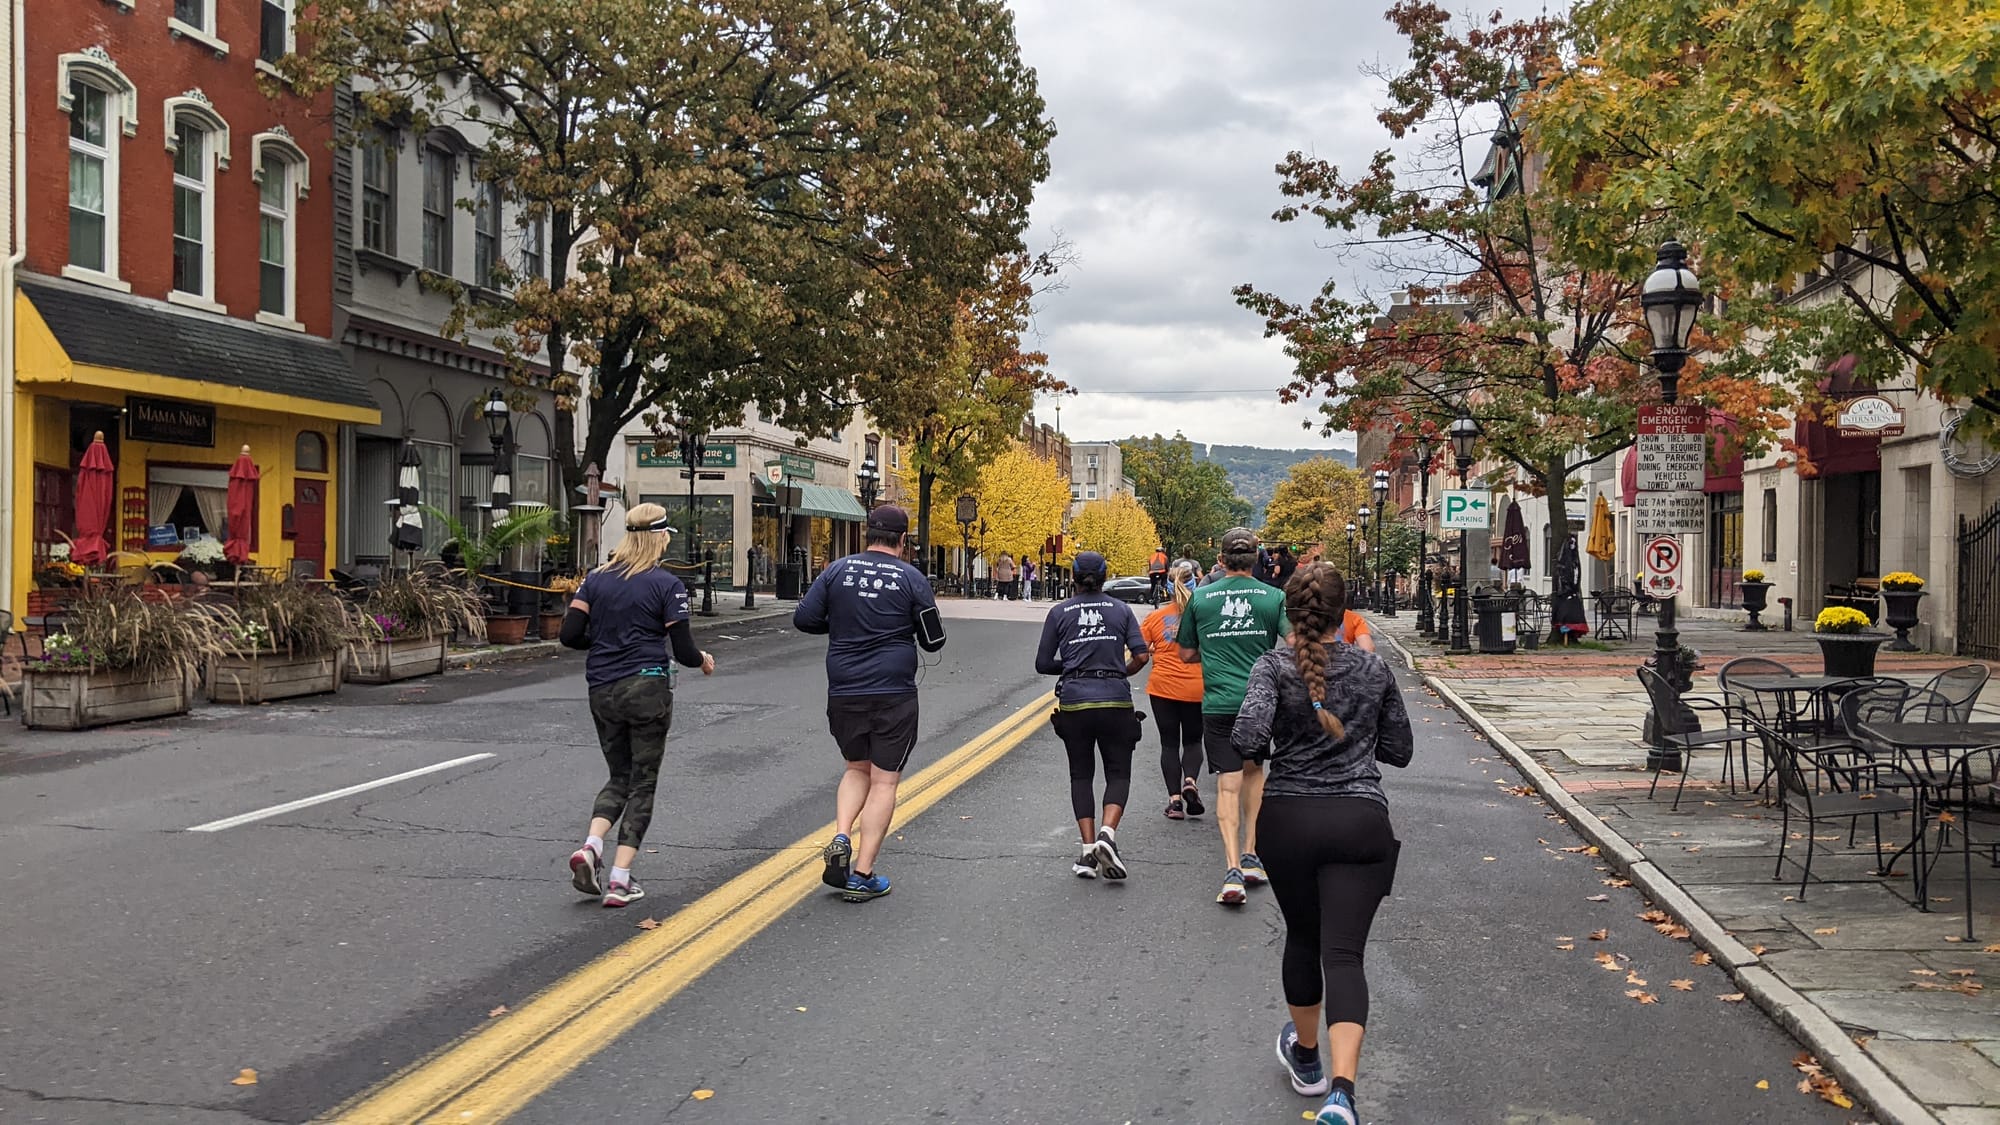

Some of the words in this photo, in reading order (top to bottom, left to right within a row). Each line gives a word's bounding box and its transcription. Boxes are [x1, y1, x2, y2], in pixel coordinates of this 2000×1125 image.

[1655, 406, 1688, 415] SNOW
[1852, 401, 1890, 415] CIGARS
[139, 405, 177, 424] MAMA
[1641, 415, 1702, 425] EMERGENCY
[1843, 415, 1898, 424] INTERNATIONAL
[1655, 425, 1688, 434] ROUTE
[1641, 434, 1660, 443] SNOW
[1667, 434, 1686, 443] TIRES
[1693, 434, 1703, 442] OR
[1640, 443, 1665, 452] CHAINS
[1670, 443, 1702, 452] REQUIRED
[1643, 453, 1655, 462] NO
[1665, 453, 1699, 462] PARKING
[1637, 462, 1661, 471] DURING
[1666, 462, 1704, 471] EMERGENCY
[1654, 471, 1688, 481] VEHICLES
[1647, 480, 1669, 490] TOWED
[1675, 481, 1695, 490] AWAY
[1636, 498, 1649, 507] TUE
[1675, 498, 1690, 507] WED
[1637, 509, 1649, 518] THU
[1676, 509, 1689, 518] FRI
[1636, 519, 1649, 529] SAT
[1675, 519, 1690, 529] MON
[1205, 591, 1226, 599] Sparta
[1063, 604, 1080, 612] Sparta
[1206, 630, 1268, 638] www.spartarunners.org
